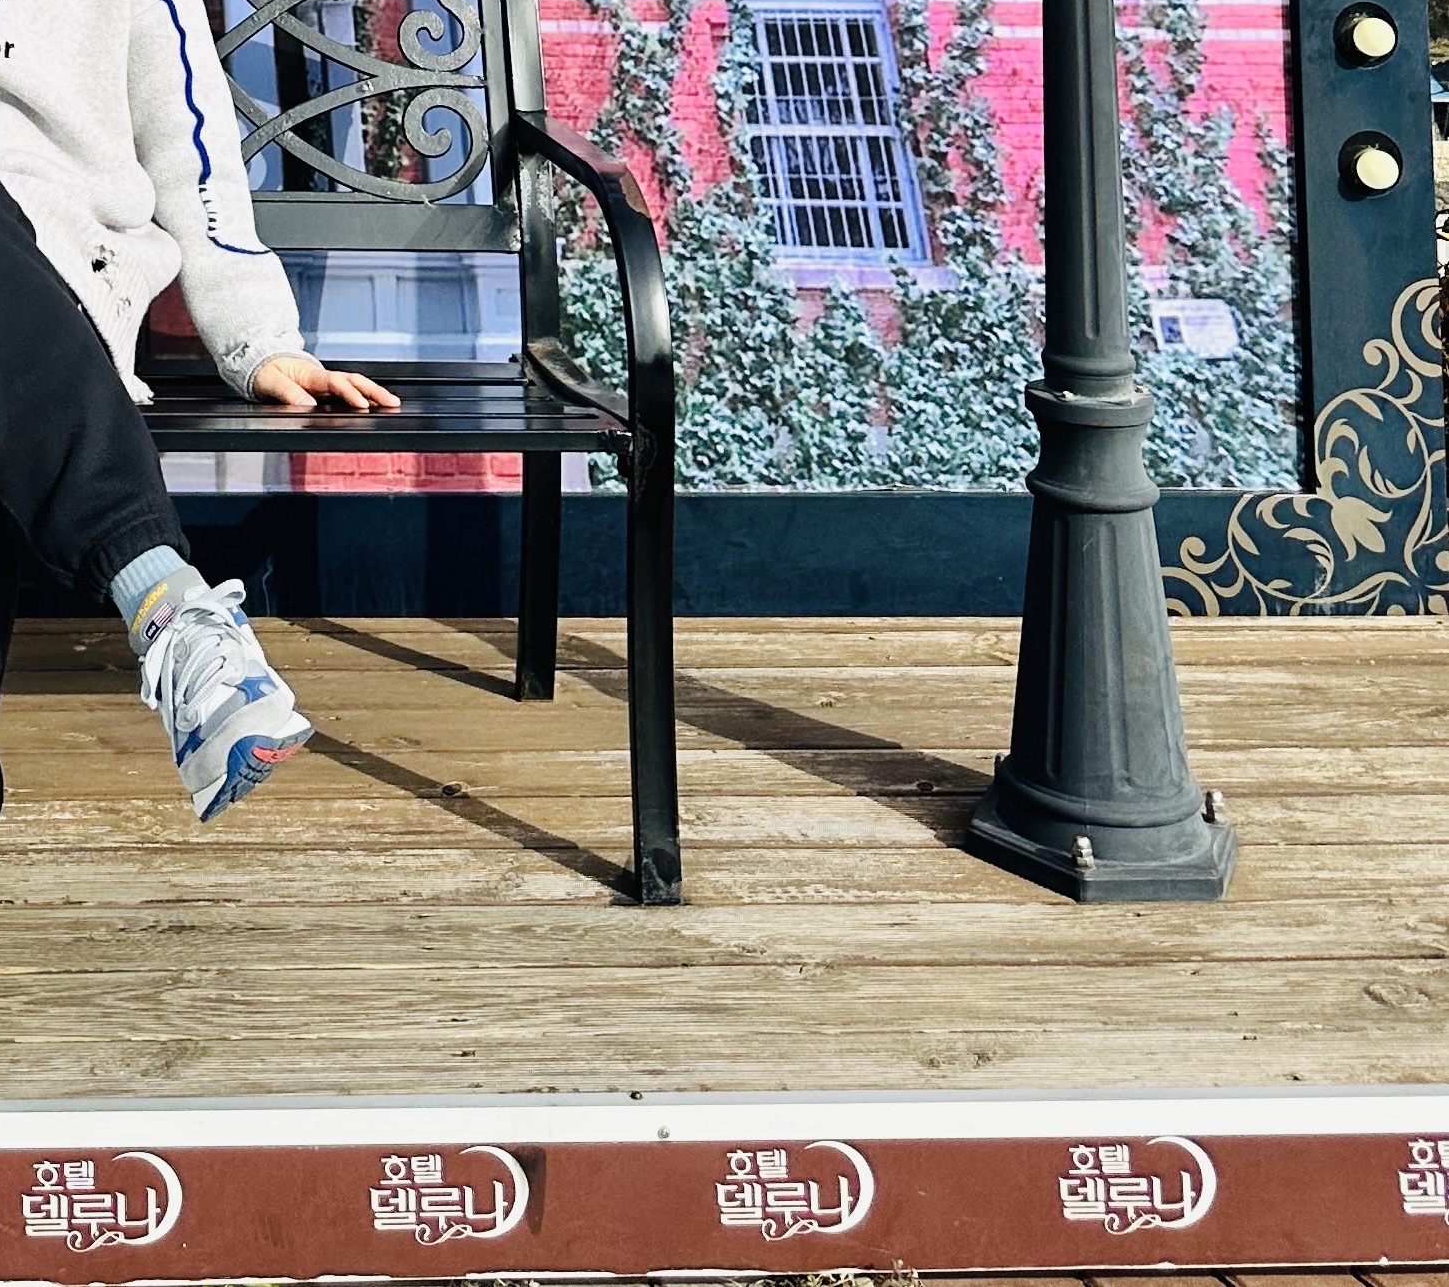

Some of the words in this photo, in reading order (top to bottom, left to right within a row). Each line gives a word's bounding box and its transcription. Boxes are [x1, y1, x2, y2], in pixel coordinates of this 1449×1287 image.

[32, 1161, 95, 1190] 호텔
[380, 1155, 442, 1184] 호텔
[726, 1149, 788, 1179] 호텔
[1069, 1145, 1130, 1174] 호텔
[22, 1188, 180, 1252] 델루나
[370, 1182, 527, 1245] 델루나
[716, 1177, 872, 1240] 델루나
[1059, 1170, 1216, 1234] 델루나
